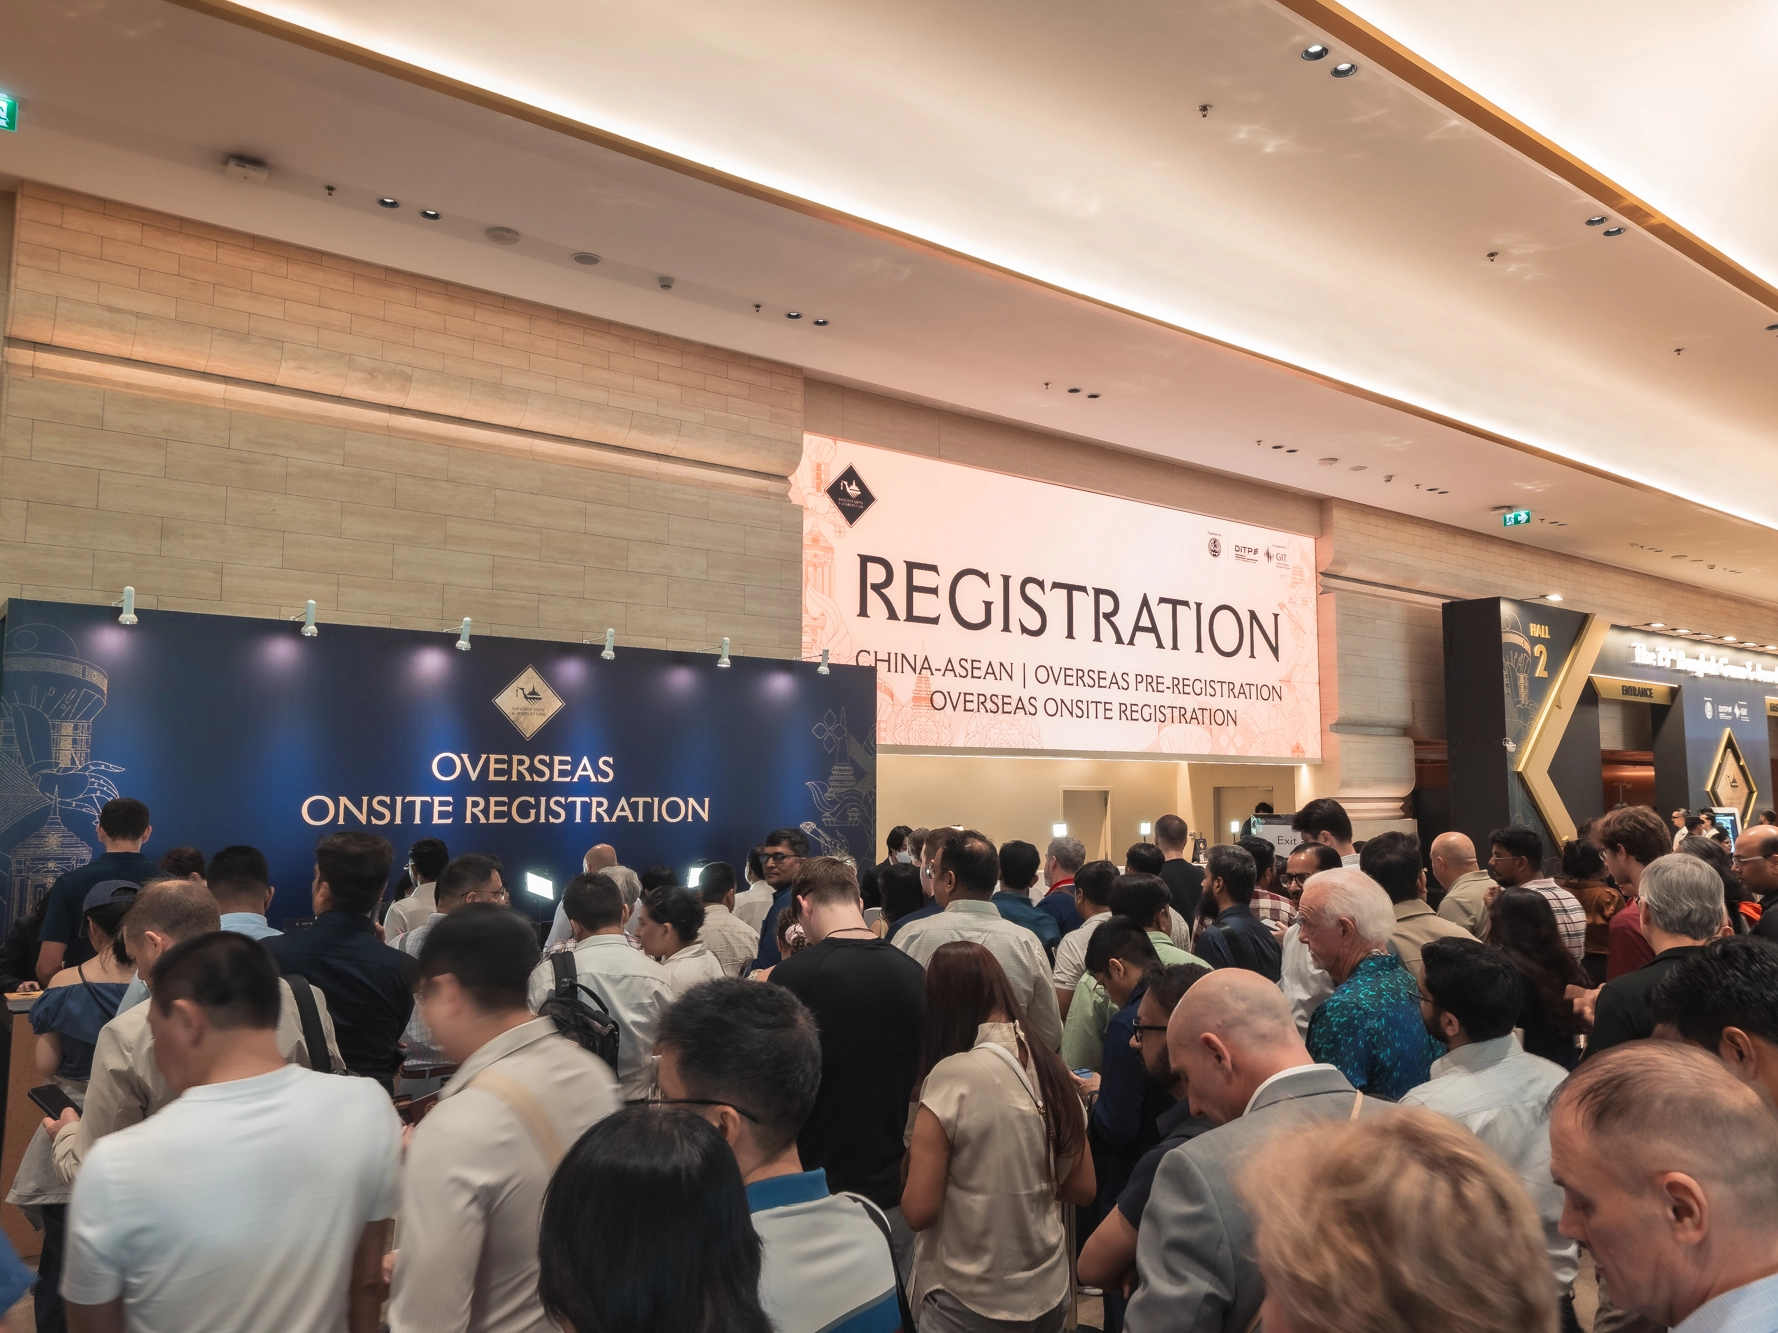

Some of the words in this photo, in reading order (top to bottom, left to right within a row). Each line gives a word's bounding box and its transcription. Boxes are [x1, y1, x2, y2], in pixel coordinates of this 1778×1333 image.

[857, 554, 1281, 662] REGISTRATION
[1529, 623, 1550, 639] HALL
[856, 649, 1014, 683] CHINA-ASEAN
[1034, 664, 1130, 691] OVERSEAS
[1134, 673, 1283, 702] PRE-REGISTRATION
[1534, 643, 1548, 678] 2
[1621, 685, 1654, 698] ENTRANCE
[929, 690, 1038, 716] OVERSEAS
[1043, 697, 1113, 720] ONSITE
[1118, 702, 1238, 726] REGISTRATION
[432, 752, 614, 783] OVERSEAS
[301, 795, 453, 826] ONSITE
[465, 796, 710, 824] REGISTRATION
[1277, 835, 1297, 846] Exit
